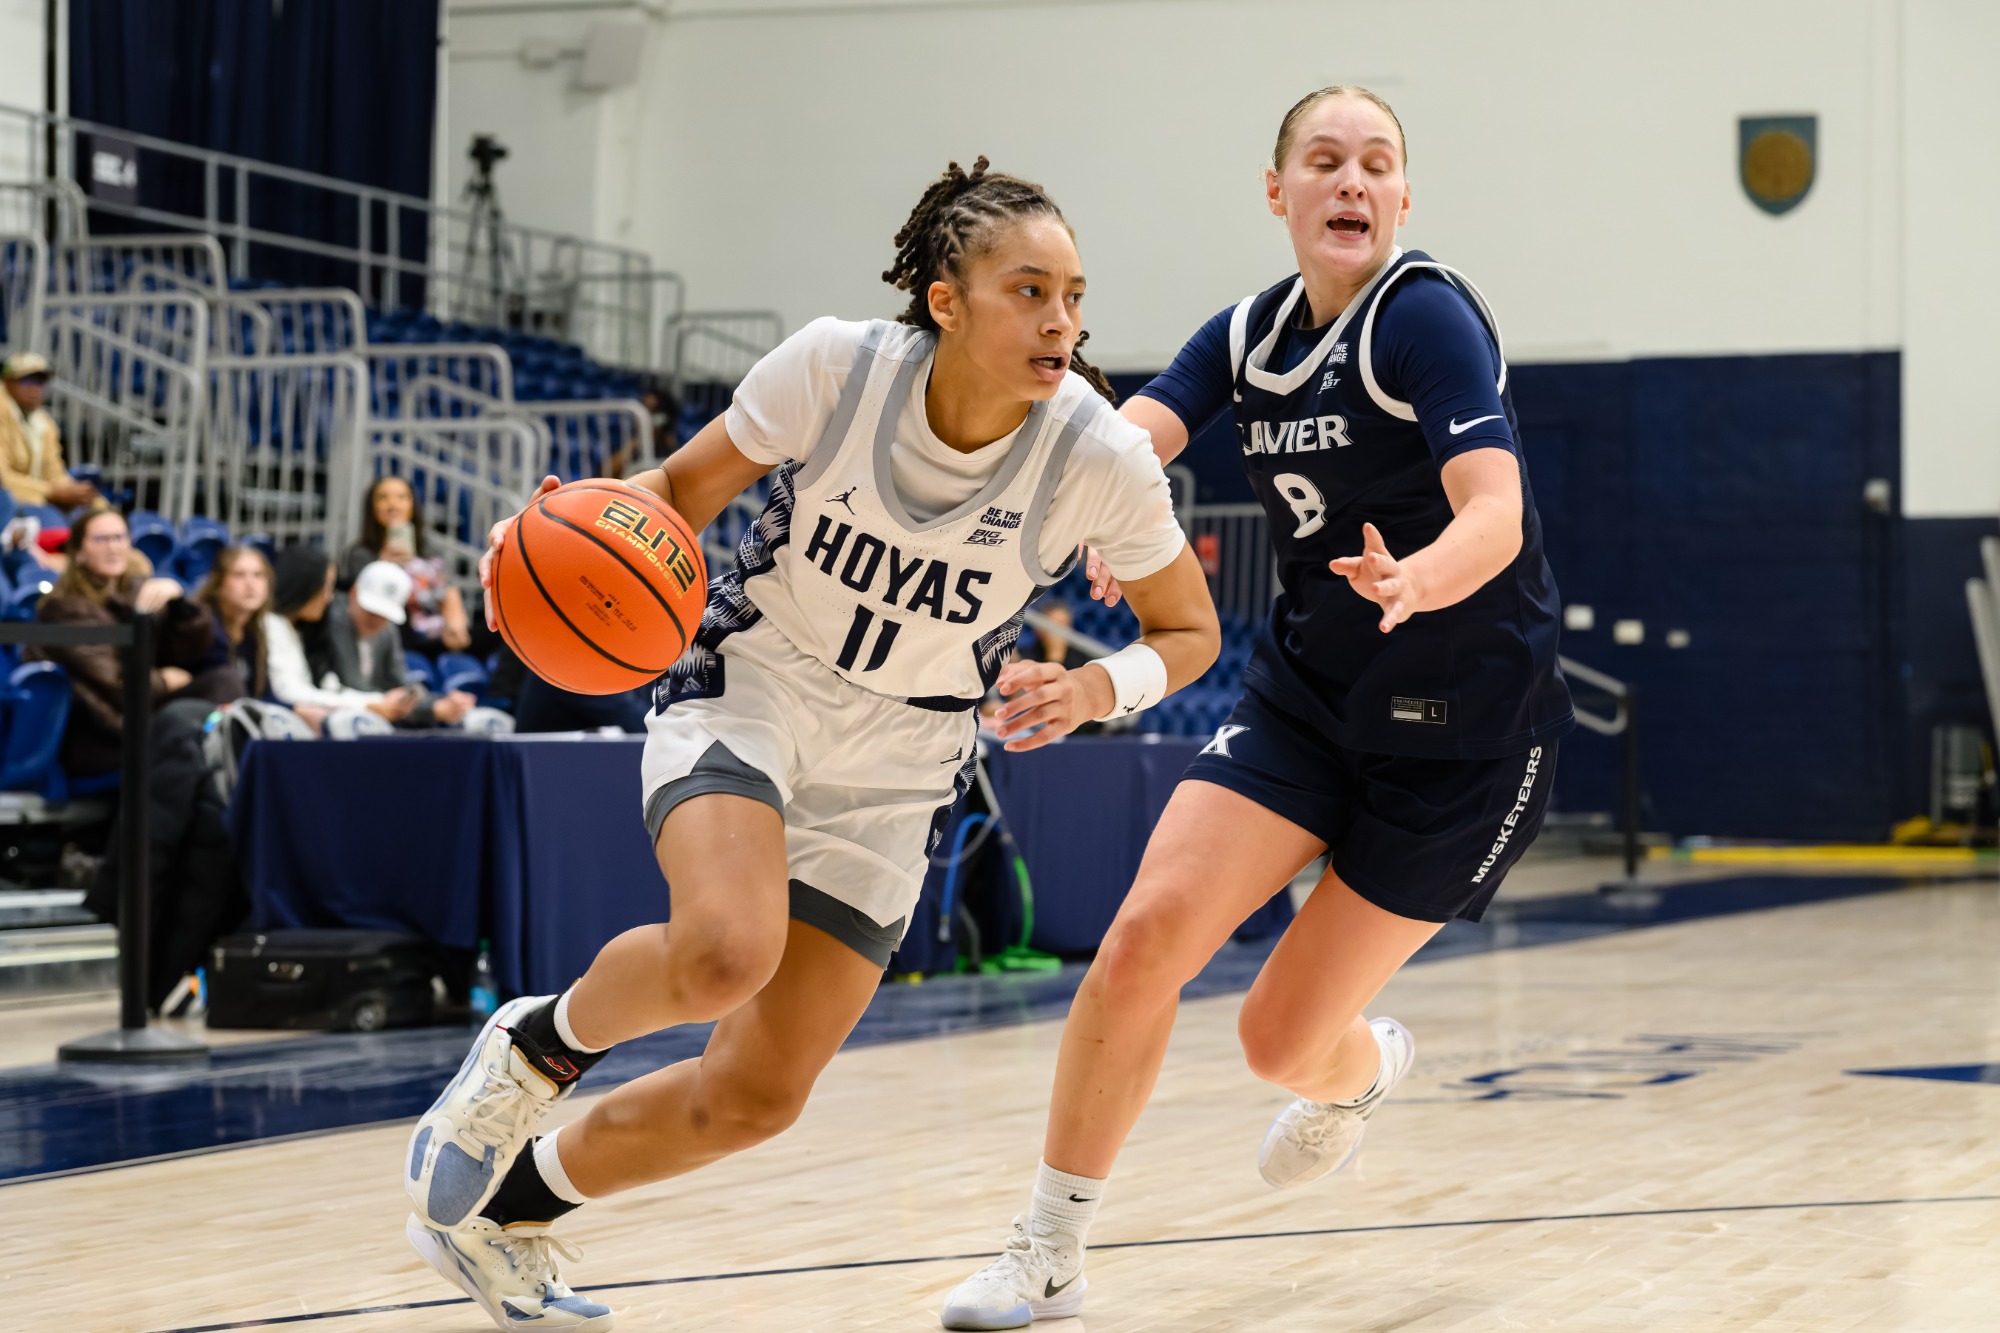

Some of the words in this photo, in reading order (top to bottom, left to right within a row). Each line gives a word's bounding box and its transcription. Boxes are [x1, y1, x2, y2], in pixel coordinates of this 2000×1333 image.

[1320, 378, 1341, 389] AST
[979, 514, 1022, 529] CHANGE
[986, 506, 1003, 518] BE
[1004, 510, 1024, 521] THE
[1273, 472, 1328, 539] 8
[599, 498, 697, 593] ELITE
[966, 535, 1008, 546] EAST
[972, 528, 1002, 539] BIG
[594, 519, 683, 600] CHAMPIONSHIP
[804, 514, 993, 625] HOYAS
[835, 603, 903, 673] 11
[1431, 706, 1438, 717] L
[1197, 724, 1251, 759] X
[1470, 745, 1543, 884] MUSKETEERS
